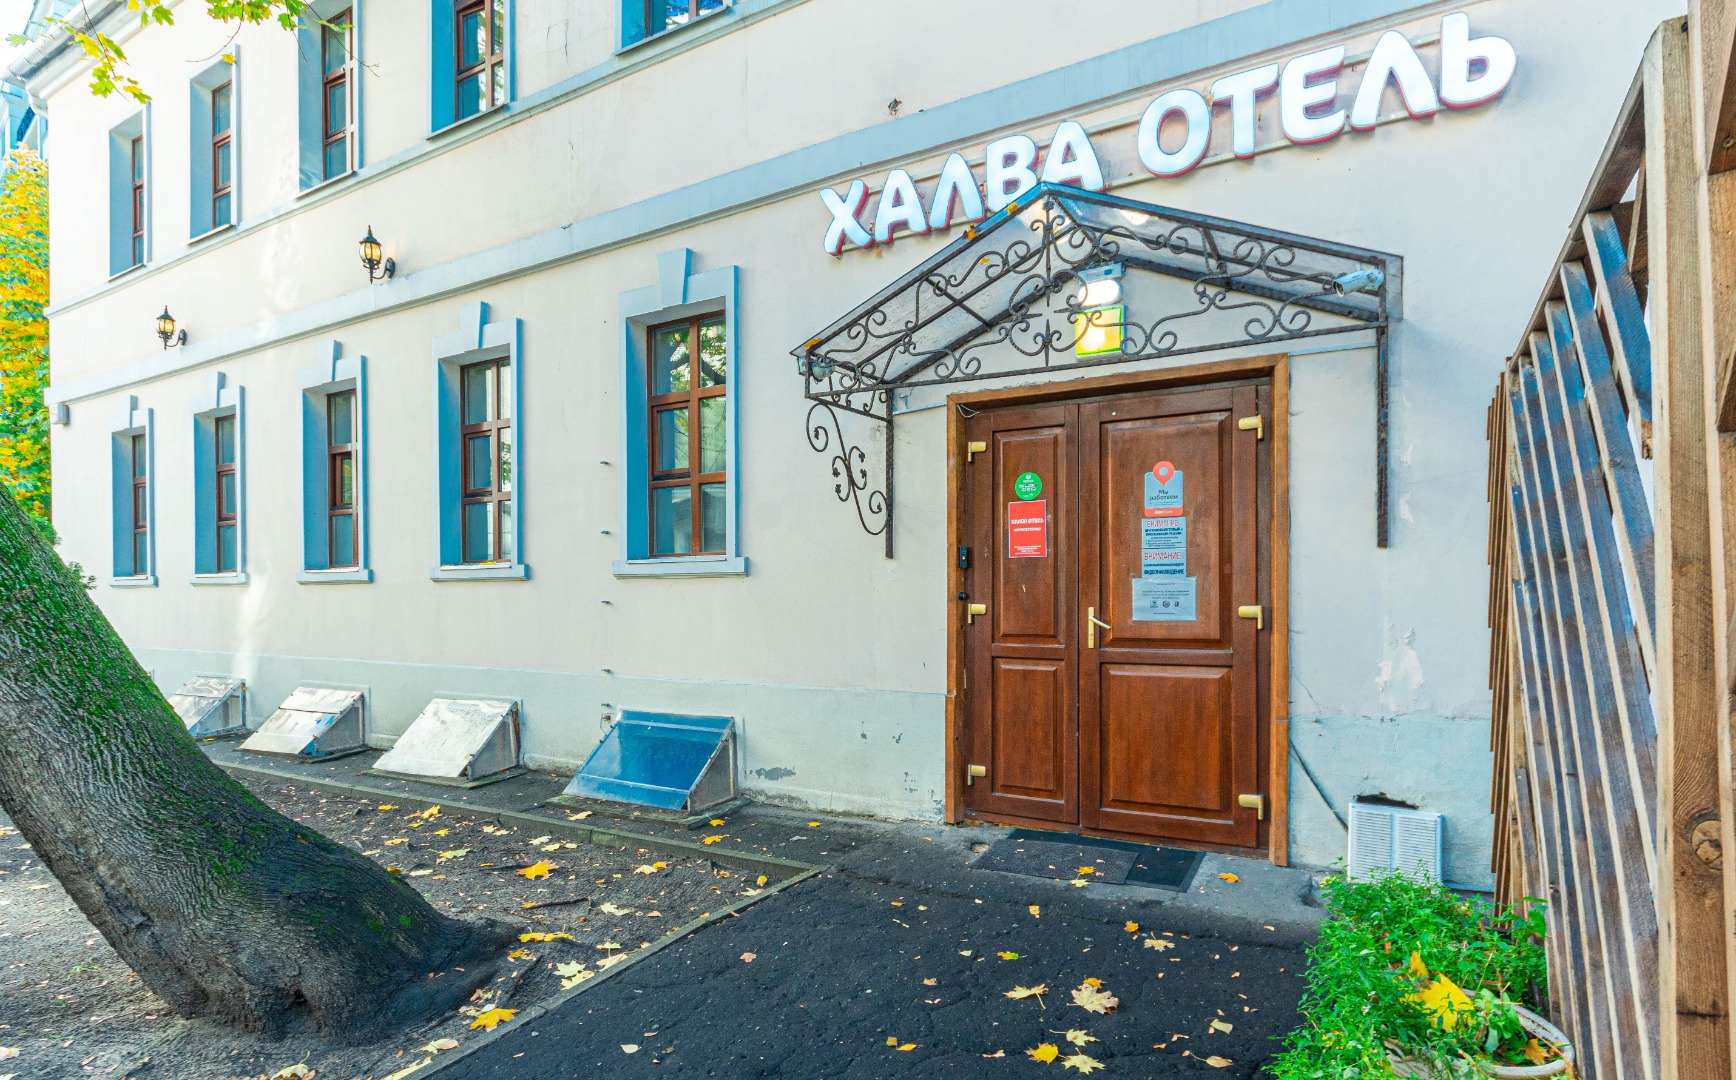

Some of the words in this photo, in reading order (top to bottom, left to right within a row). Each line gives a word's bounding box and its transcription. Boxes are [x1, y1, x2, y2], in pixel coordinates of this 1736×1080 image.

[820, 120, 1105, 256] ХАЛВА
[1137, 11, 1518, 178] ОТЕЛЬ
[1144, 552, 1181, 561] ВНИМАНИЕ
